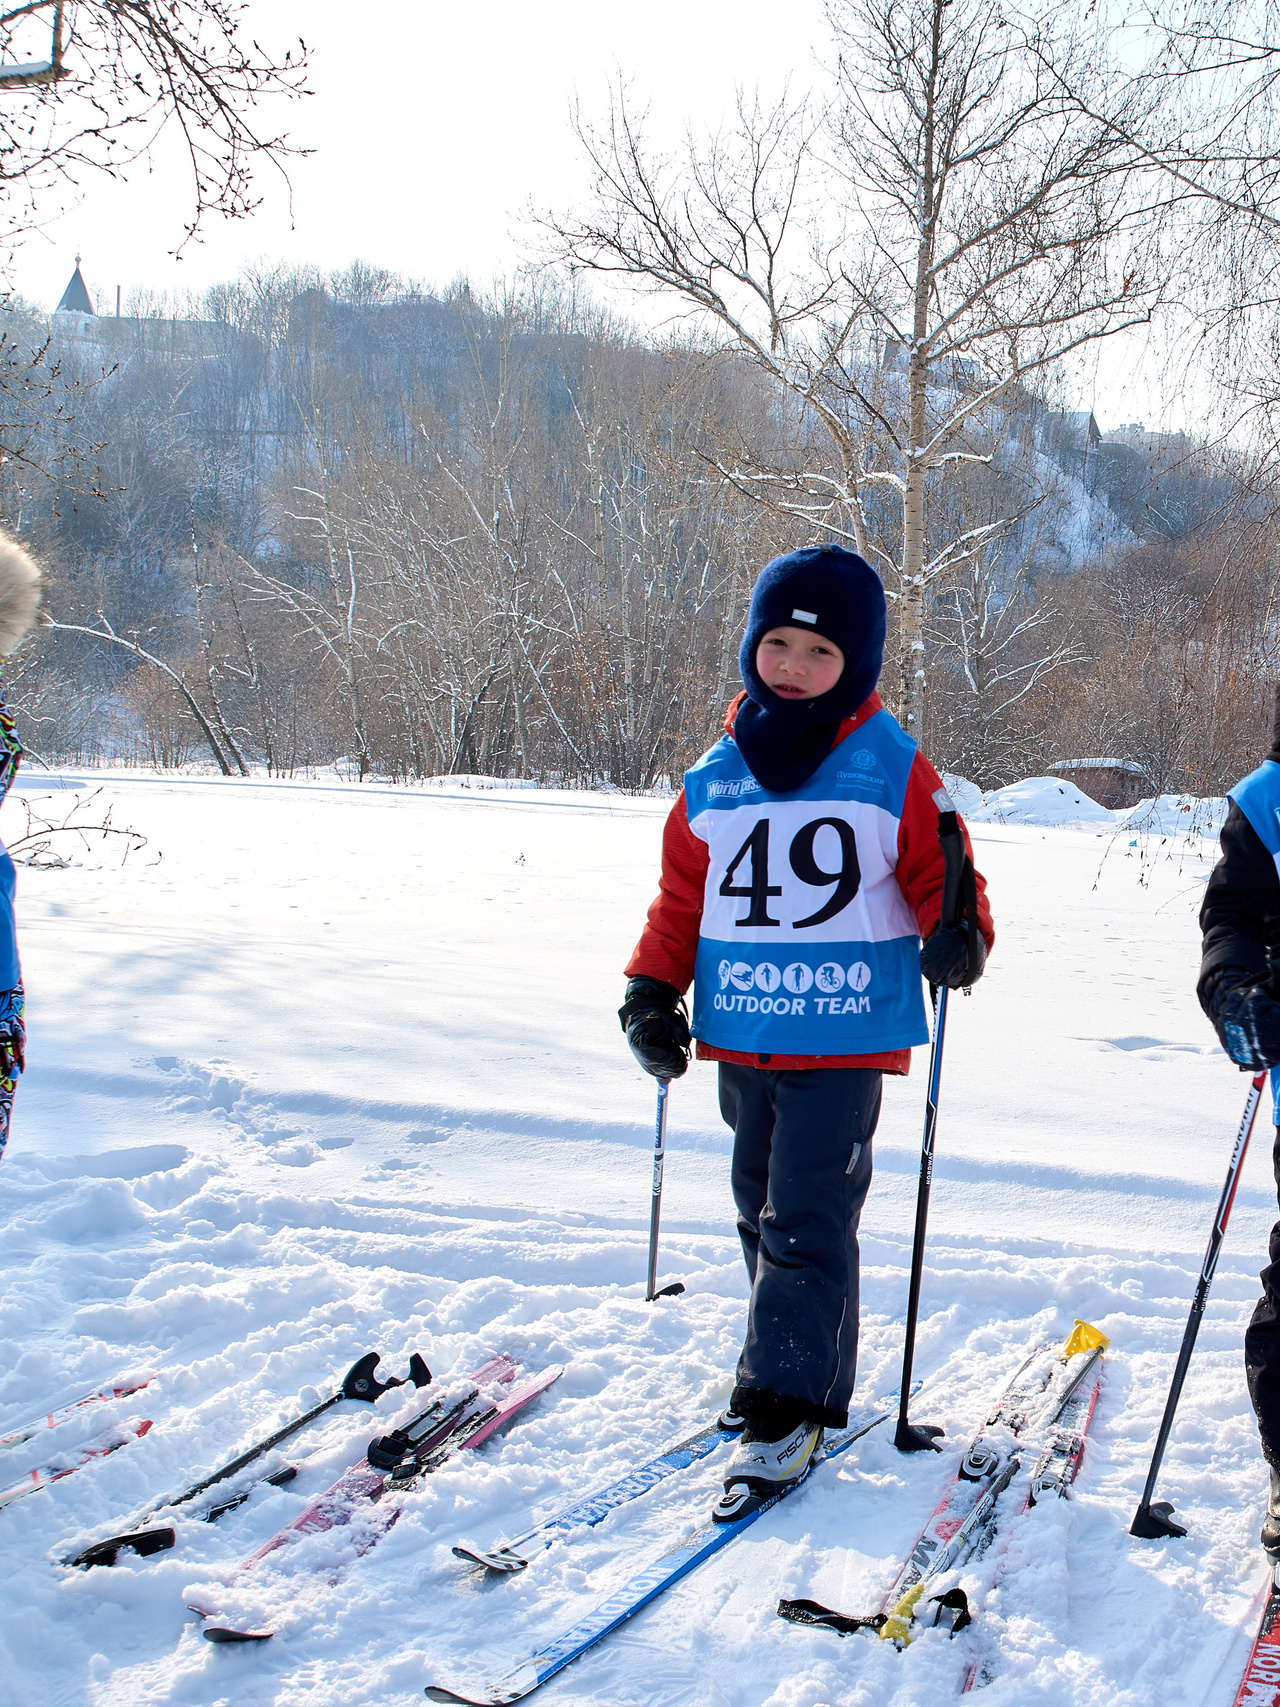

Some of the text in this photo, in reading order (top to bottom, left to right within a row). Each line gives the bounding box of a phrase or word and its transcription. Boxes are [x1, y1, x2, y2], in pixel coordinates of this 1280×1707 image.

[707, 781, 740, 798] World
[719, 817, 862, 930] 49
[713, 992, 872, 1016] OUTDOOR TEAM
[776, 1422, 815, 1466] FISCHE
